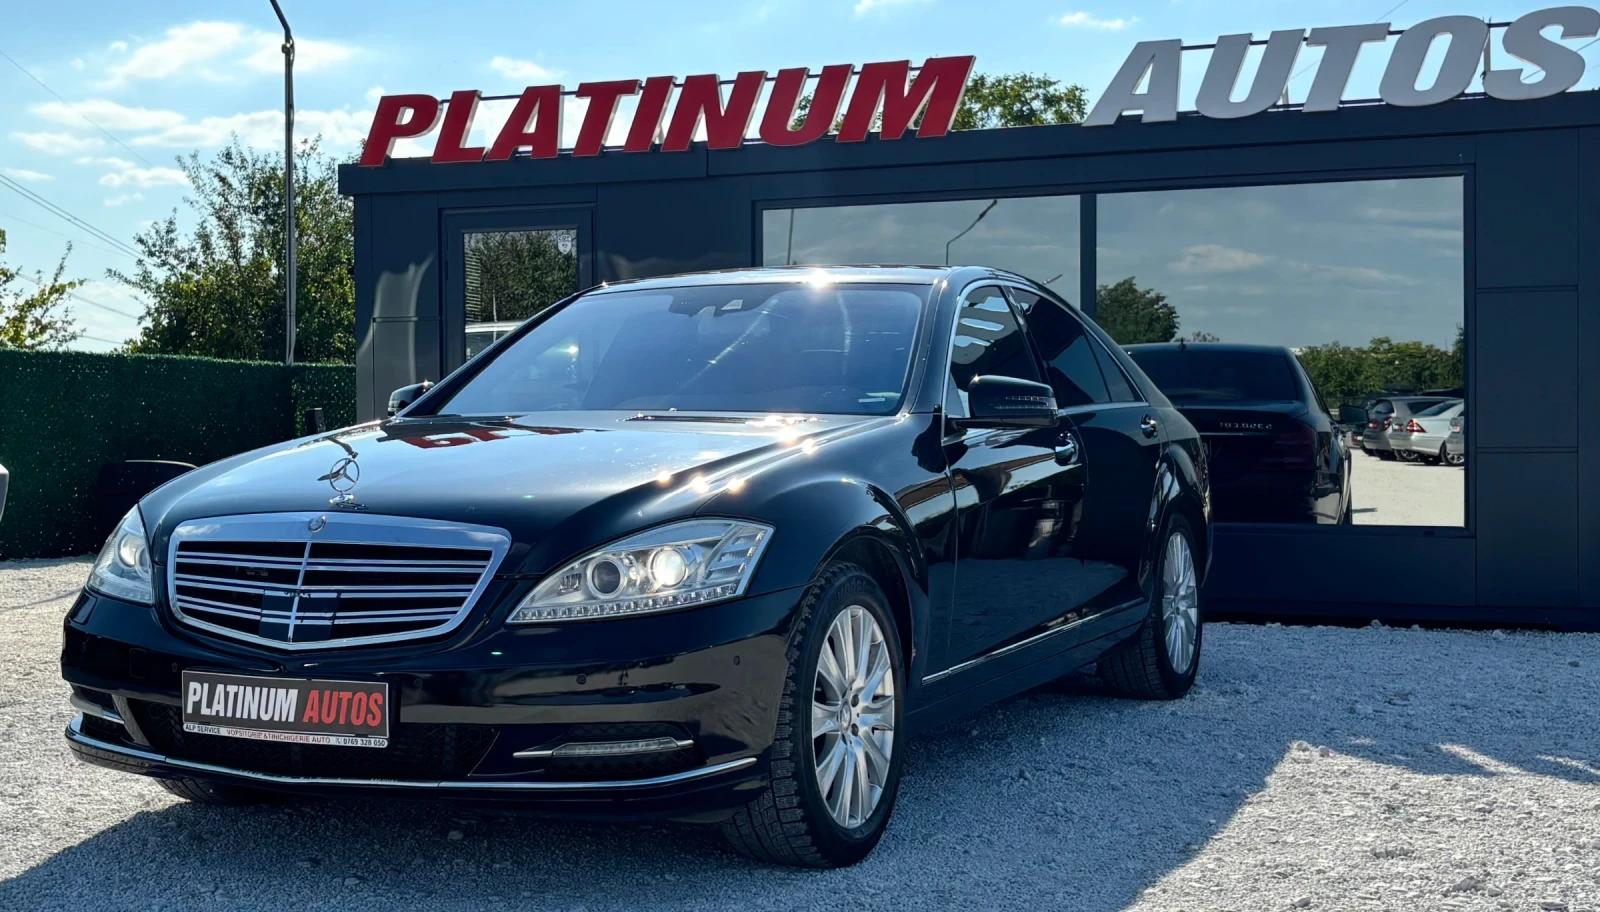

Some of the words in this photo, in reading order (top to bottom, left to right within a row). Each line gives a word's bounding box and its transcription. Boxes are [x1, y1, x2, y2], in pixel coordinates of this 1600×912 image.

[359, 55, 977, 168] PLATINUM
[1081, 6, 1600, 127] AUTOS
[186, 681, 299, 723] PLATINUM
[302, 689, 384, 727] AUTOS
[185, 723, 197, 731] ALP
[197, 725, 221, 734] SERVICE
[311, 736, 331, 744] AUTO
[343, 738, 359, 746] 0769
